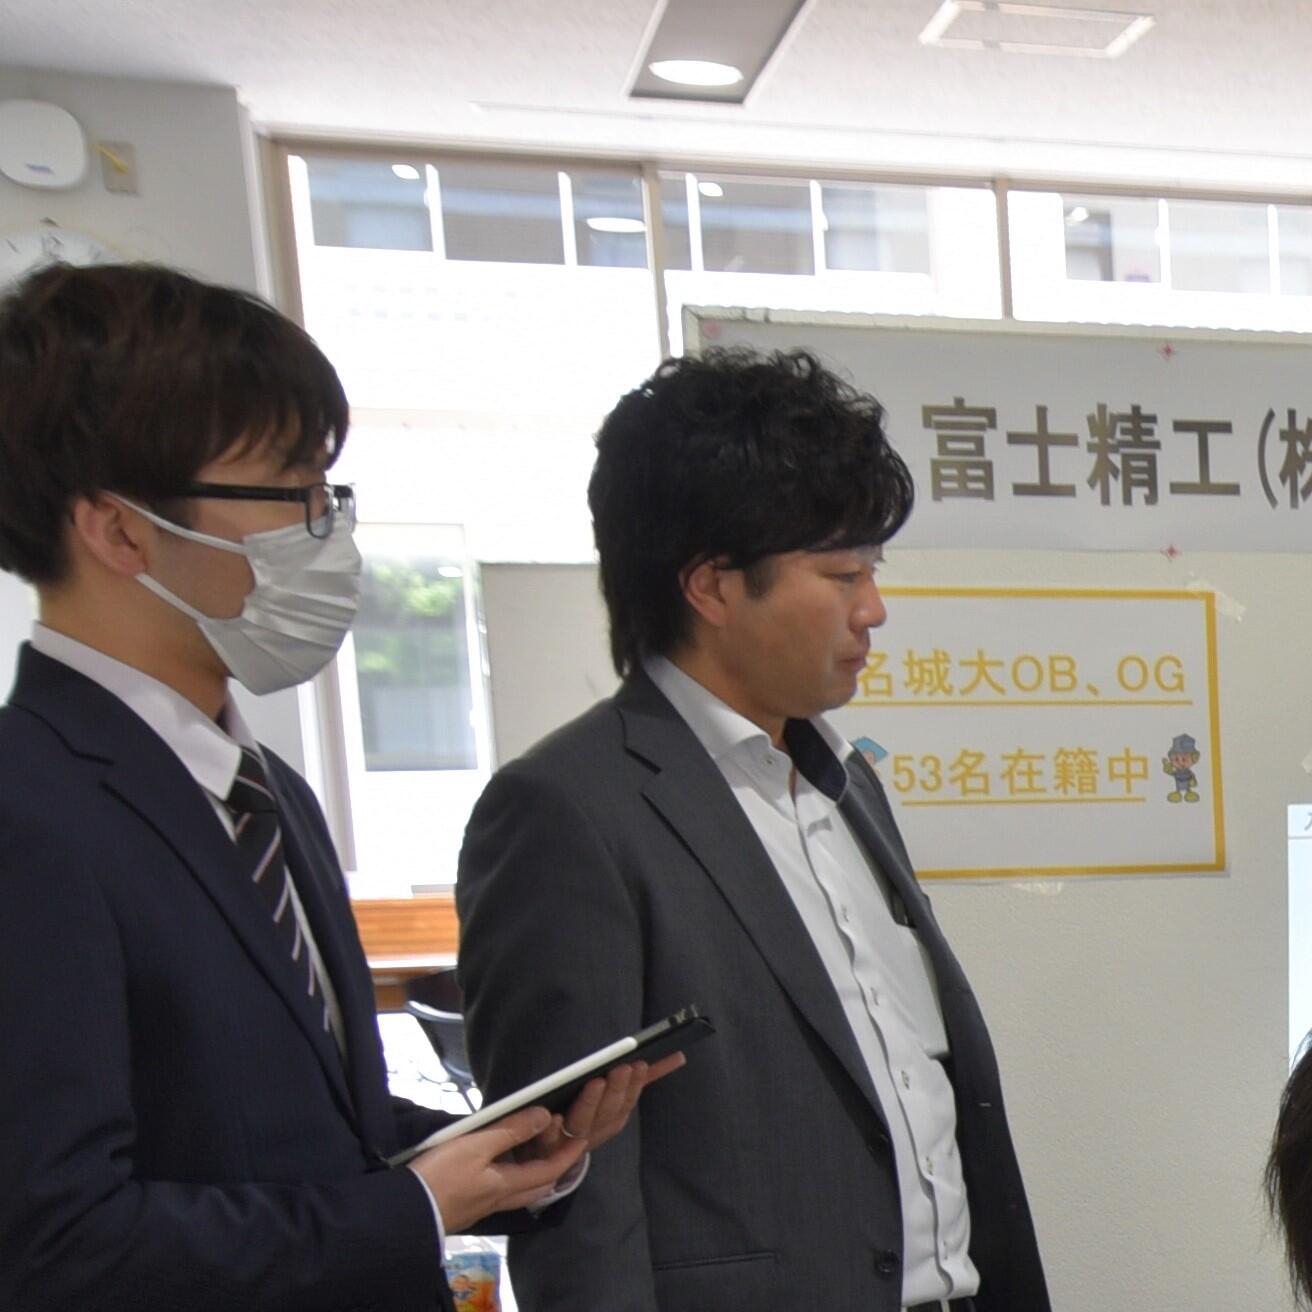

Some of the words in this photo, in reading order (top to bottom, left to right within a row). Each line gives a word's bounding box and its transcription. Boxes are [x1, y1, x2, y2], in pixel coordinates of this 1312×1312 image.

[856, 648, 1186, 697] 名城大OB、OG
[891, 747, 1150, 796] 53名在籍中
